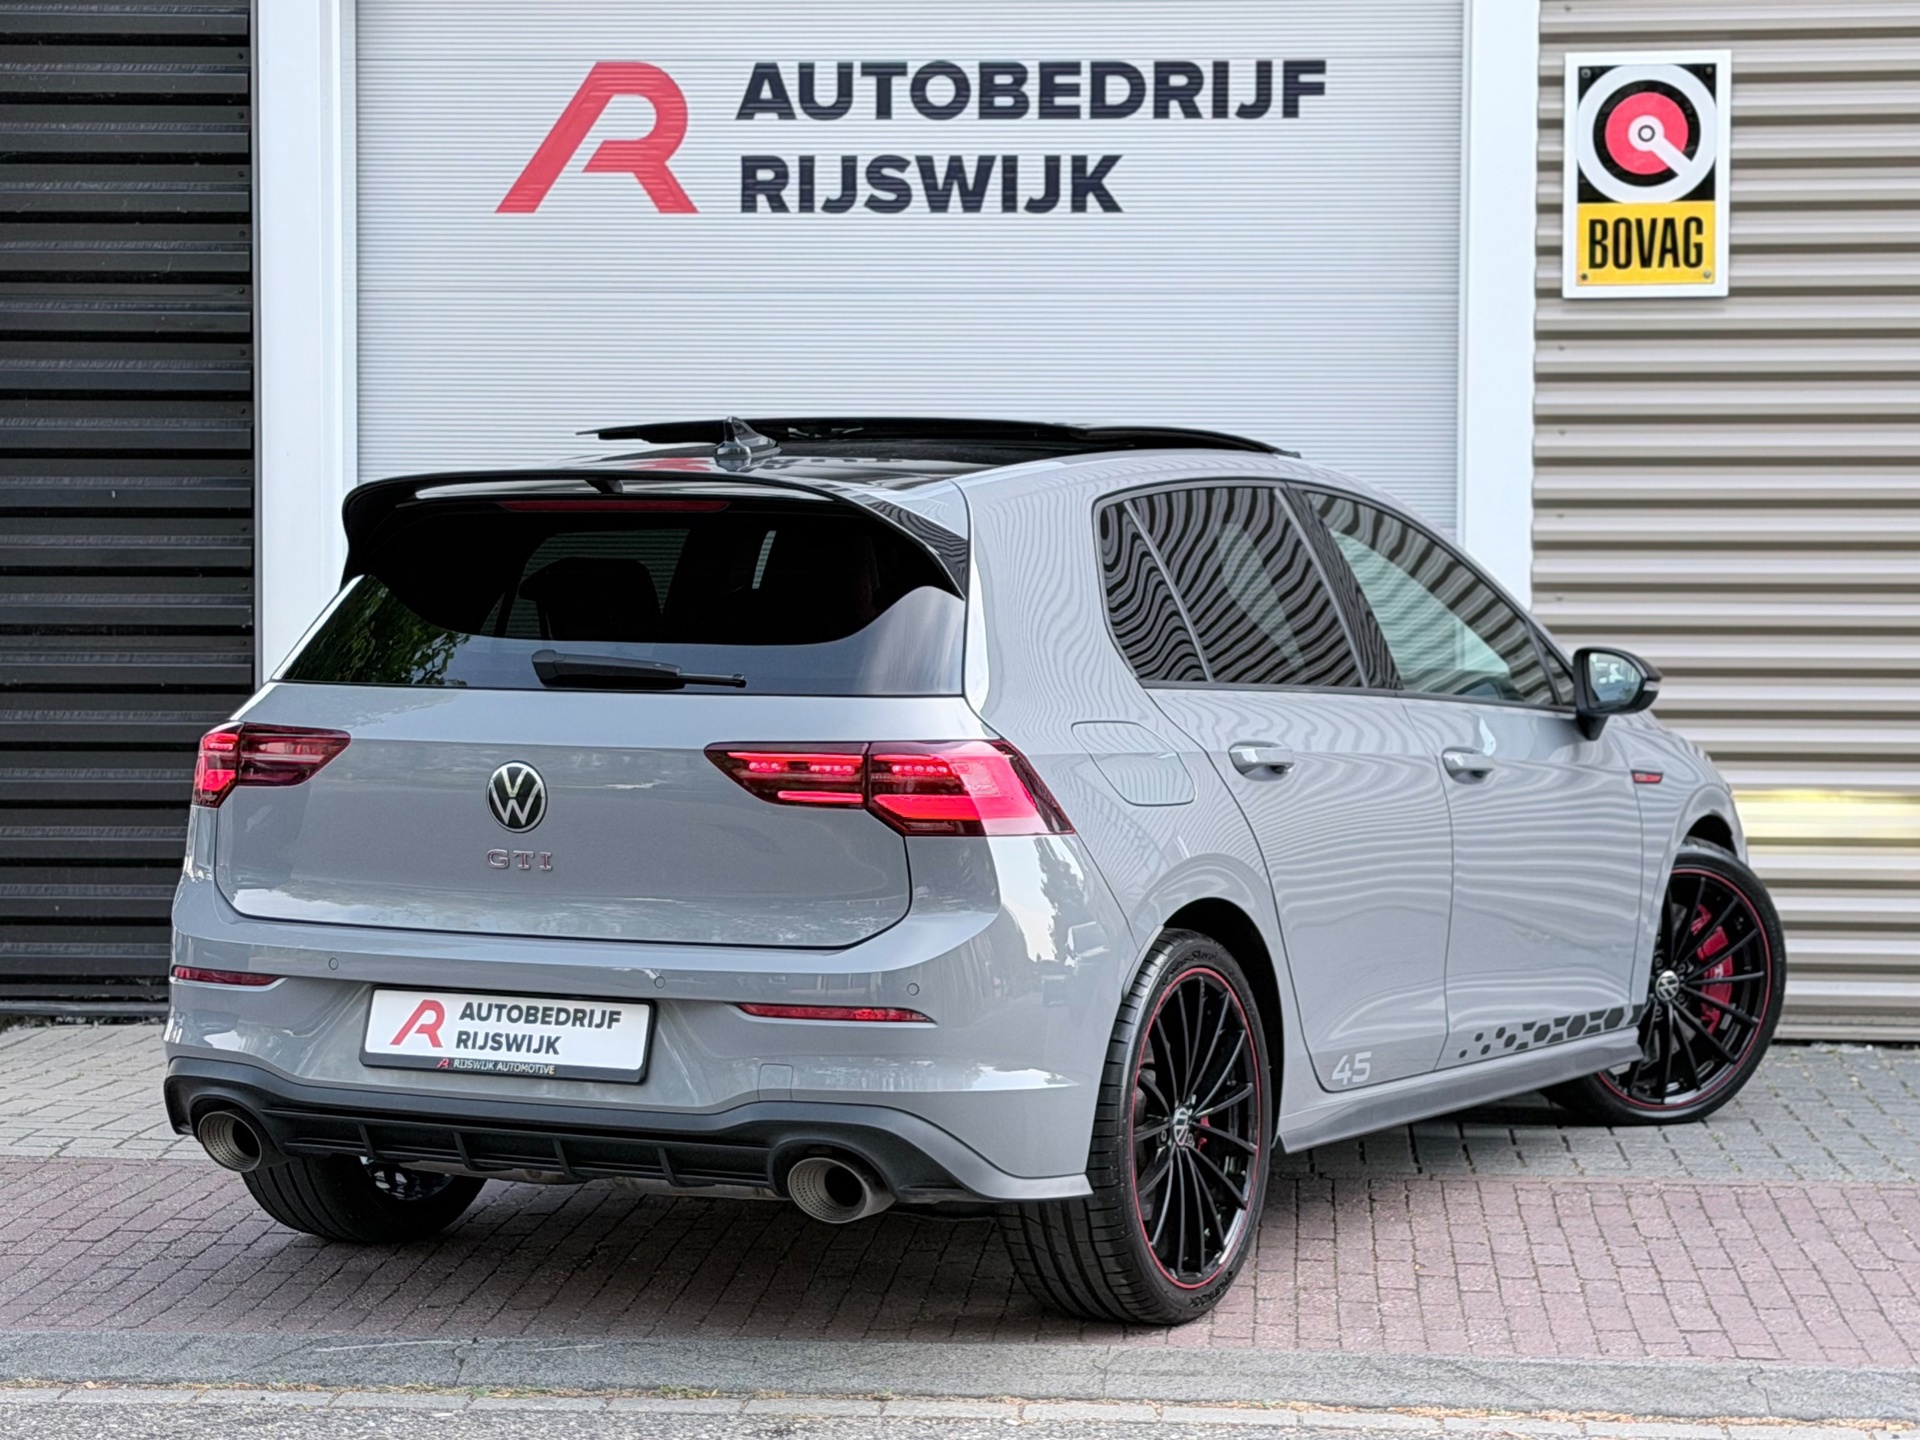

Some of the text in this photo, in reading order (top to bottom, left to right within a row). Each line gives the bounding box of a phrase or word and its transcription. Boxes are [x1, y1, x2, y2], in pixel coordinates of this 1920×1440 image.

[735, 60, 1327, 120] AUTOBEDRIJF
[740, 154, 1123, 214] RIJSWIJK
[1588, 216, 1704, 270] BOVAG
[487, 848, 553, 871] GTI
[459, 1002, 622, 1030] AUTOBEDRIJF
[455, 1030, 562, 1055] RIJSWIJK
[453, 1058, 495, 1071] RIJSWIJK
[496, 1062, 556, 1076] AUTOMOTIVE
[1331, 1051, 1372, 1086] 45
